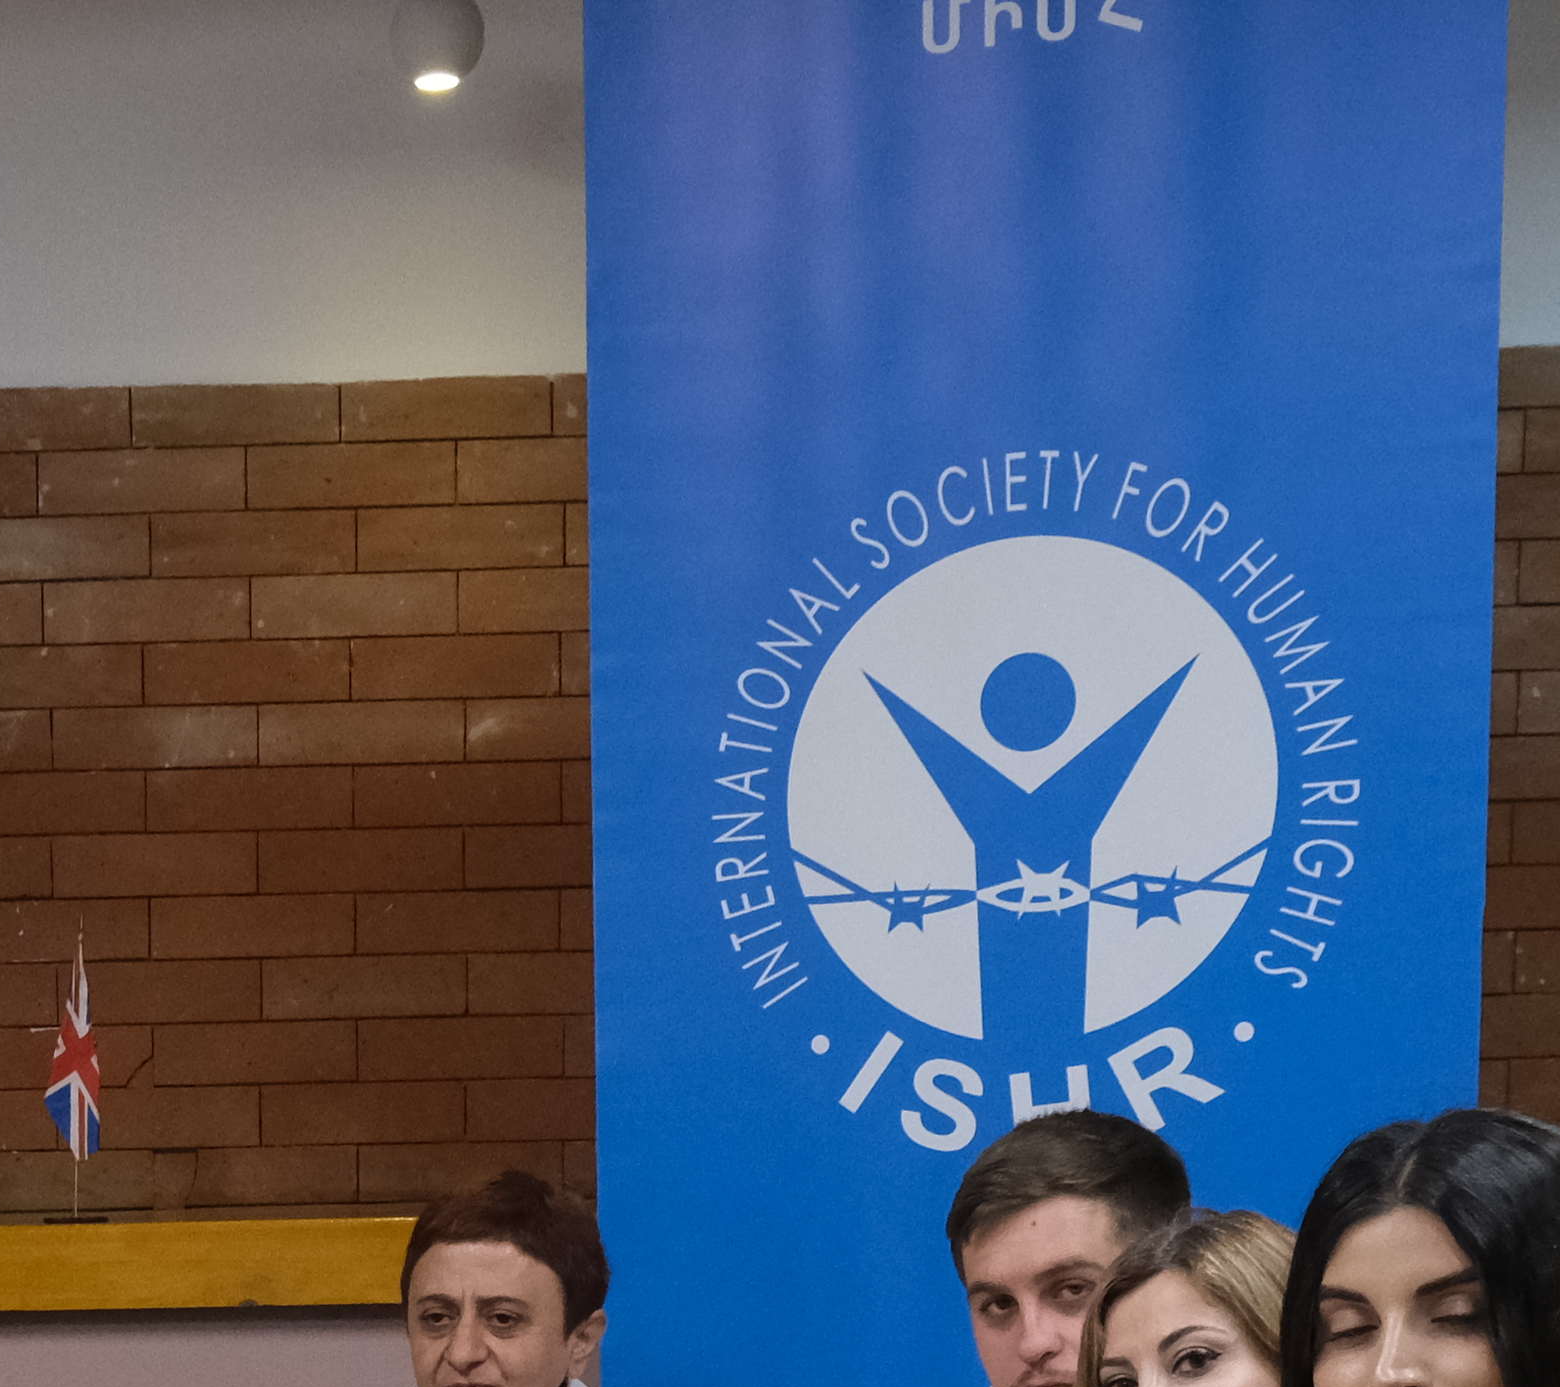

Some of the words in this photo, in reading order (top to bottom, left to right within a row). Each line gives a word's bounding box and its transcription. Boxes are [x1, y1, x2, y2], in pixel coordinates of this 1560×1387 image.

[851, 450, 1099, 569] SOCIETY
[1112, 462, 1229, 561] FOR
[1219, 539, 1357, 755] HUMAN
[712, 558, 860, 1008] INTERNATIONAL
[1255, 778, 1360, 988] RIGHTS
[839, 1027, 1225, 1152] ISHR
